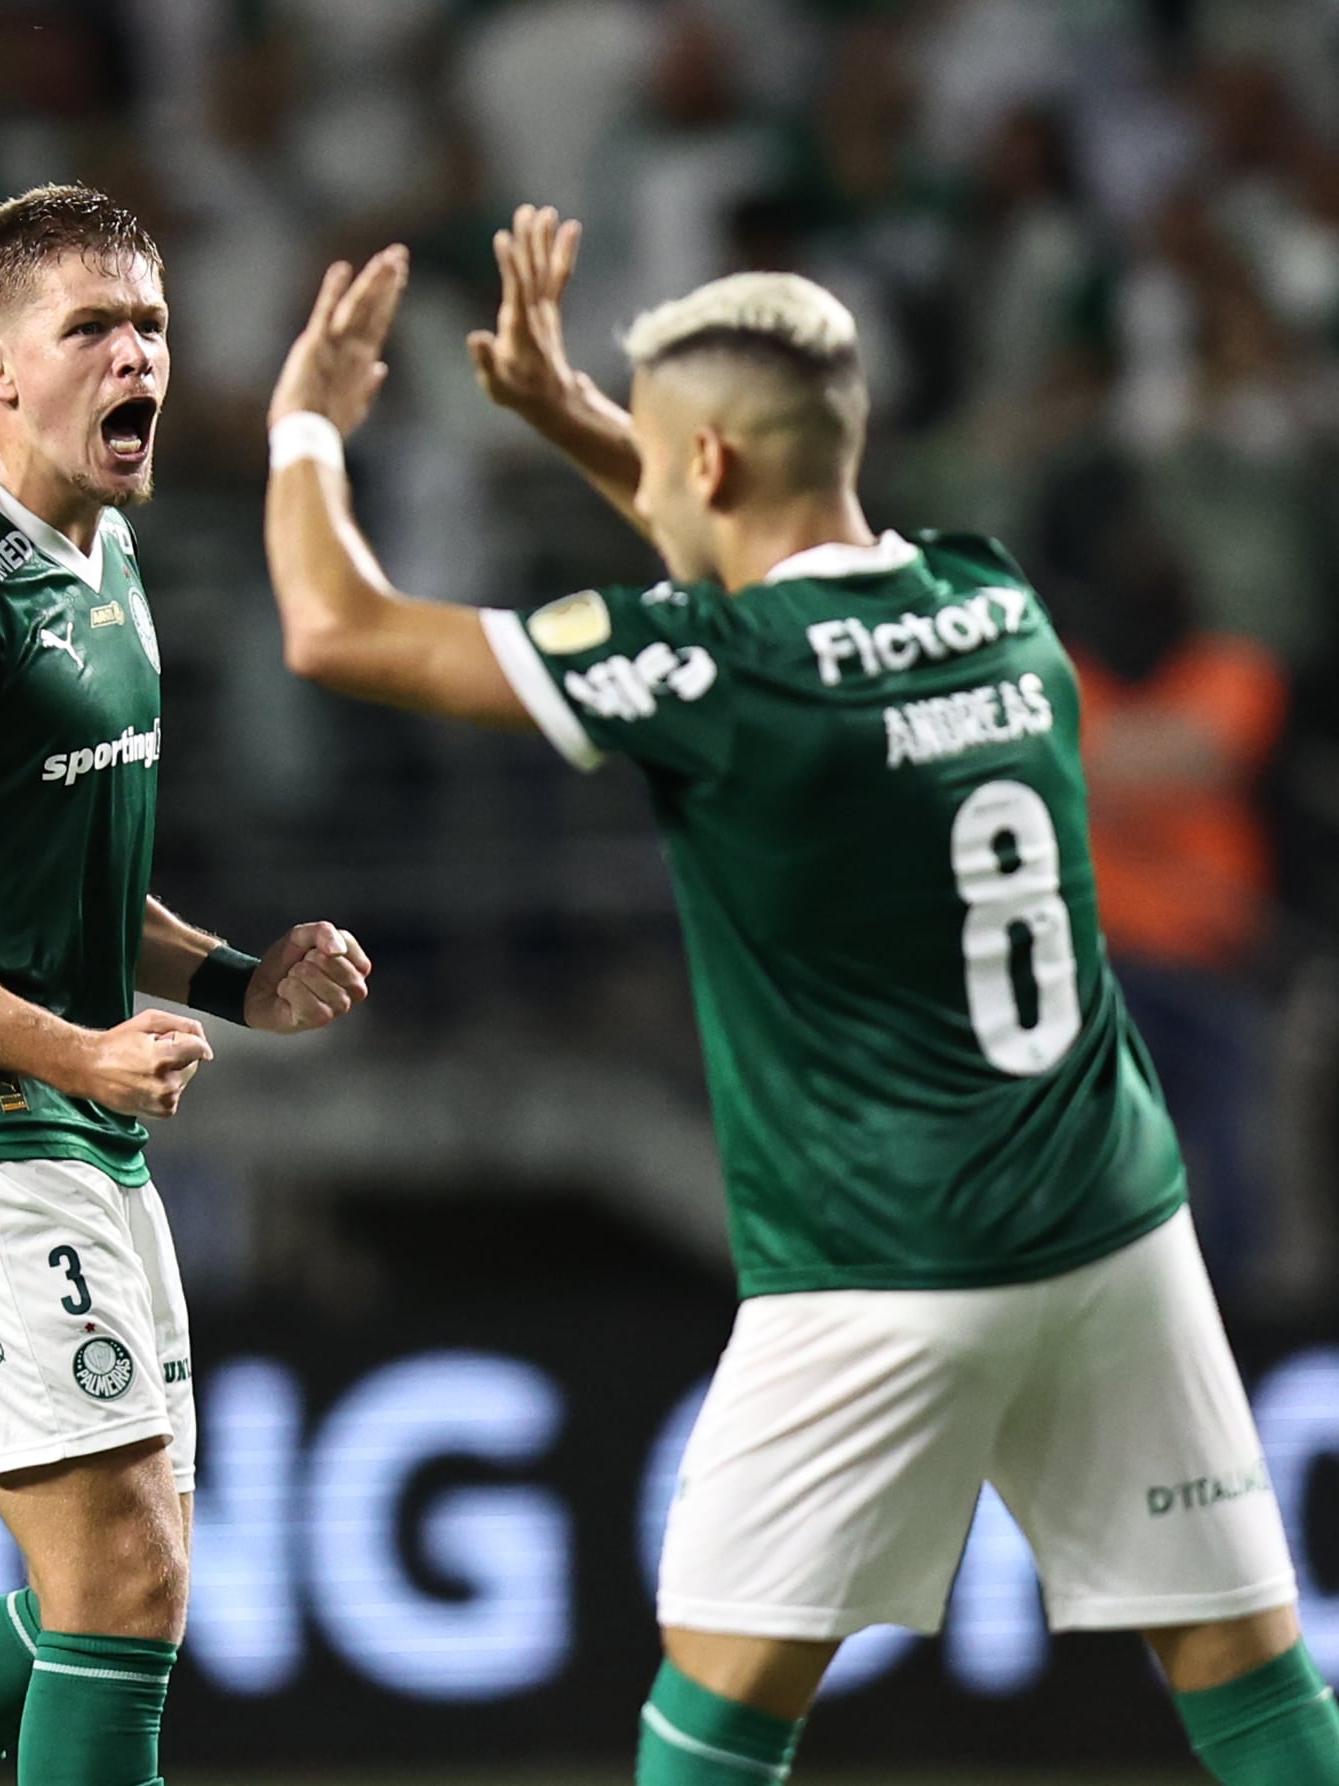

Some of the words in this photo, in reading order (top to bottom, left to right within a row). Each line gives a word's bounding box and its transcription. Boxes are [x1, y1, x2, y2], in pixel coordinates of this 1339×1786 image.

[884, 672, 1053, 768] ANDREAS
[950, 779, 1082, 1075] 8
[48, 1245, 92, 1316] 3
[76, 1357, 131, 1397] PALMEIRAS
